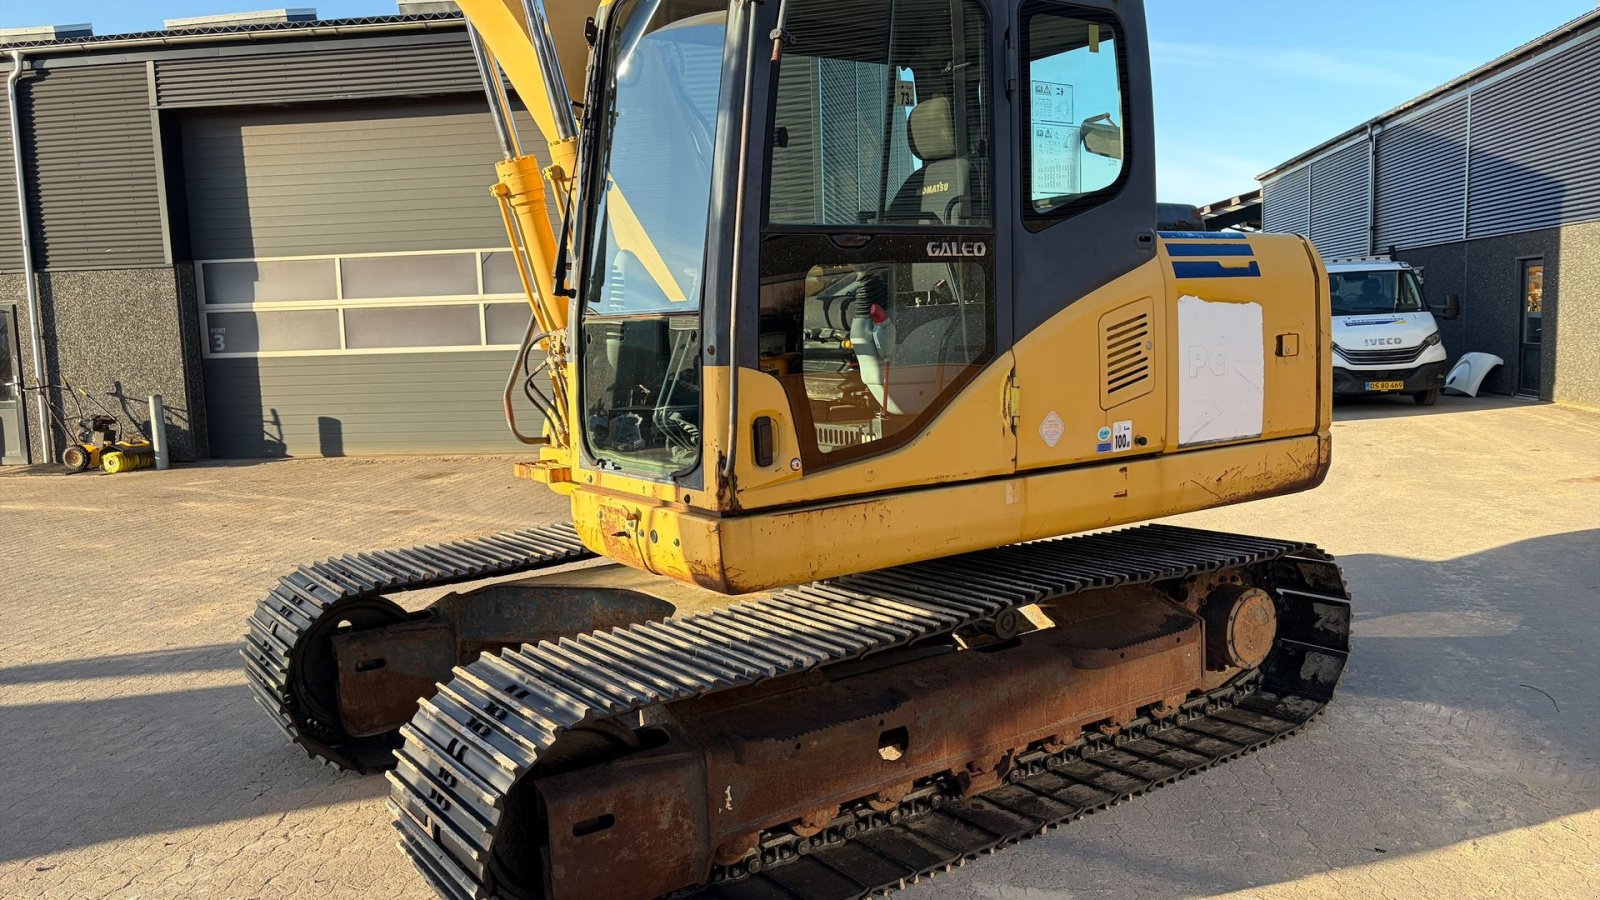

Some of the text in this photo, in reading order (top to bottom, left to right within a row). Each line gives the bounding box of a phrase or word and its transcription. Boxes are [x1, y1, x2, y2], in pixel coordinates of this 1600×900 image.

[927, 242, 987, 257] GALEO
[214, 334, 225, 352] 3
[1364, 337, 1402, 346] IVECO
[1390, 381, 1403, 389] 469
[1115, 433, 1127, 449] 100
